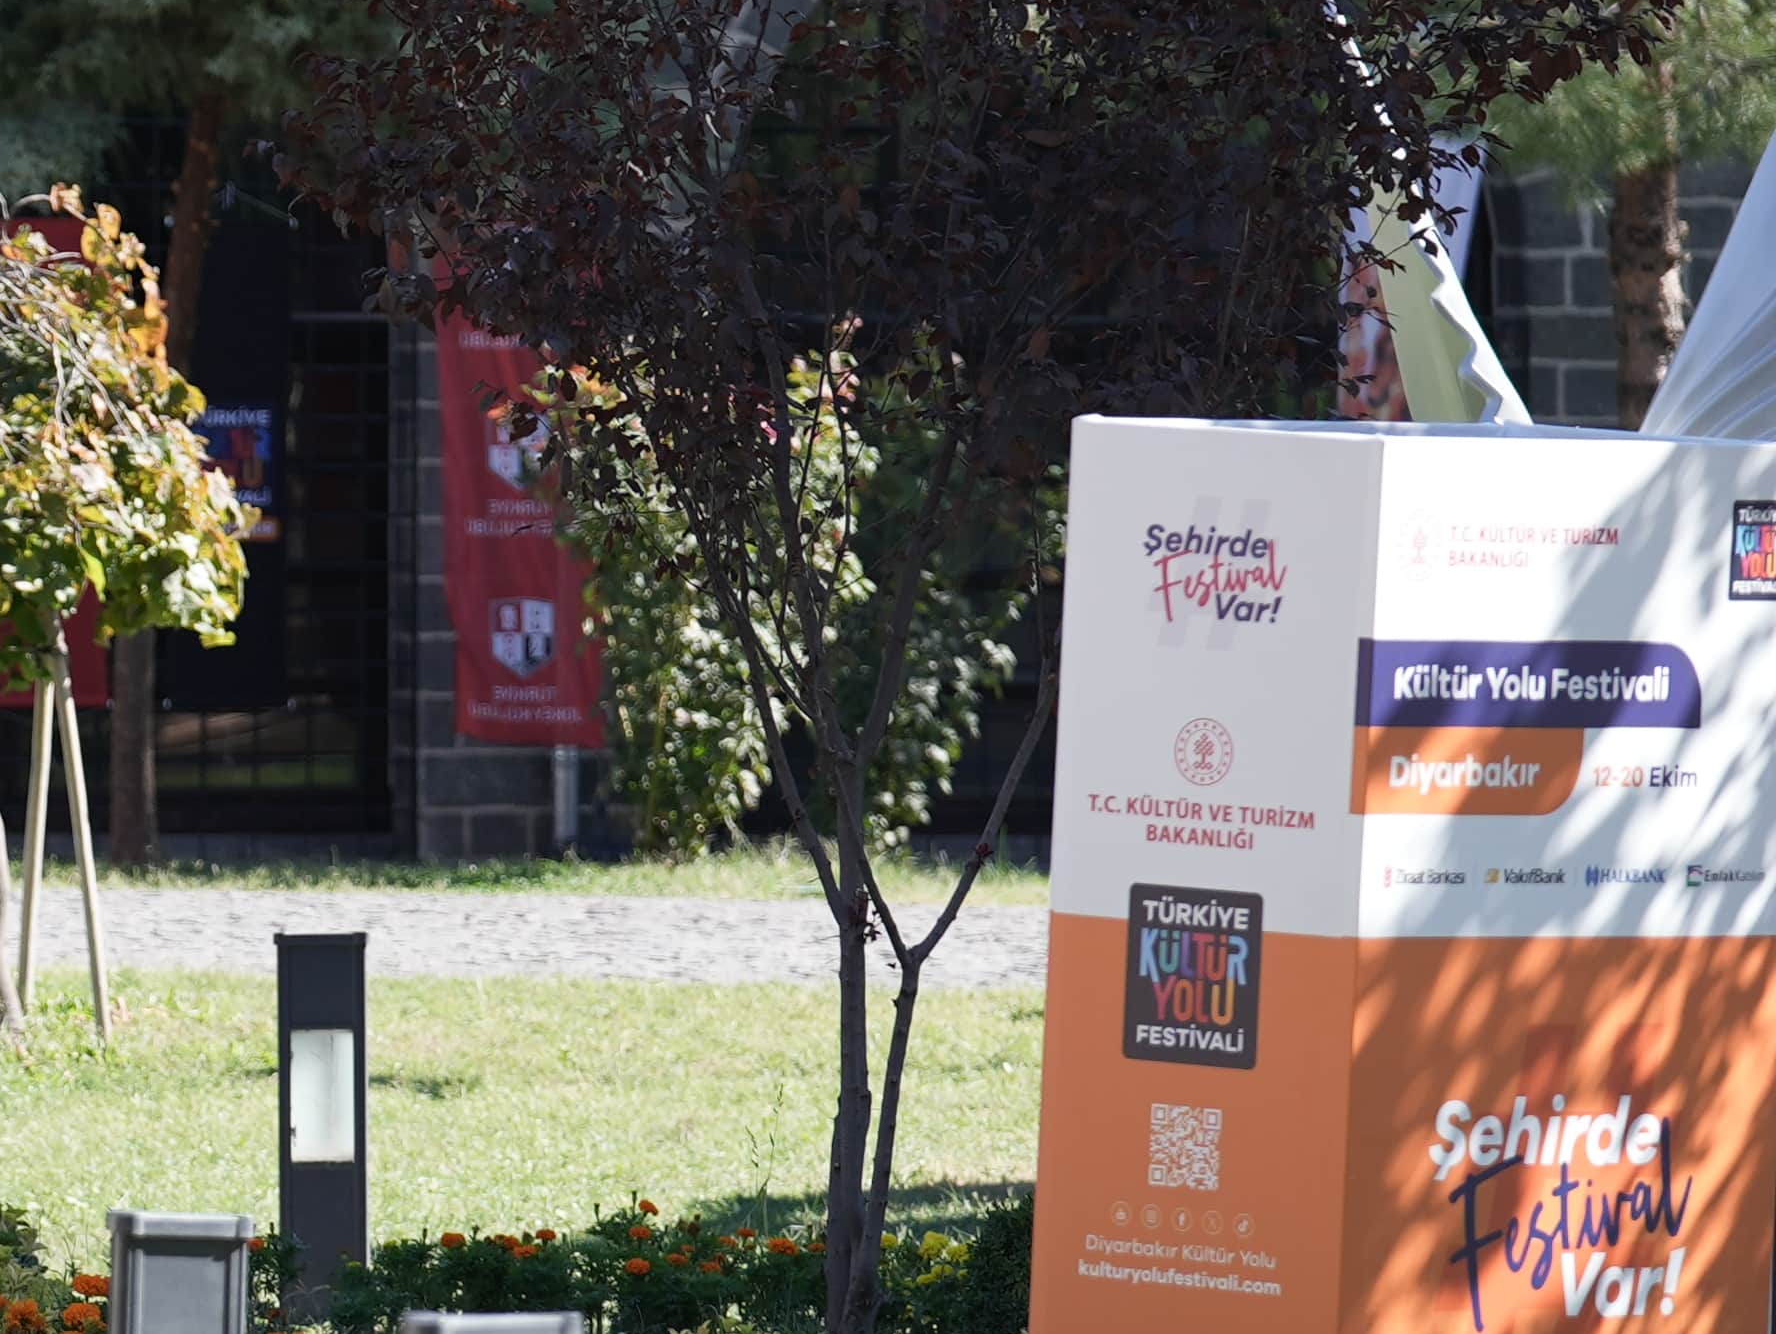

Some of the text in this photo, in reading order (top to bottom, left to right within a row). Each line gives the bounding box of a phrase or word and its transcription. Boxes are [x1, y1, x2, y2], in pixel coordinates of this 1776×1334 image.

[1144, 524, 1269, 559] Şehirde
[1563, 525, 1620, 546] TURİZM
[1153, 539, 1288, 623] Festival
[1215, 593, 1283, 624] Var!
[1393, 664, 1670, 701] Kültür Yolu Festivali
[1389, 755, 1541, 795] Diyarbakır
[1593, 764, 1697, 788] 12-20 Ekim
[1087, 793, 1315, 829] T.C. KÜLTÜR VE TURİZM
[1145, 824, 1254, 851] BAKANLIĞI
[1142, 895, 1250, 931] TÜRKİYE
[1139, 927, 1249, 985] KÜLTÜR
[1151, 974, 1236, 1026] YOLU
[1135, 1022, 1245, 1054] FESTİVALİ
[1428, 1093, 1663, 1181] Şehirde
[1449, 1116, 1693, 1334] Festival
[1085, 1233, 1277, 1270] Diyarbakır Kültür Yolu
[1077, 1258, 1282, 1297] kulturyolufestivali.com
[1560, 1247, 1687, 1318] Var!
